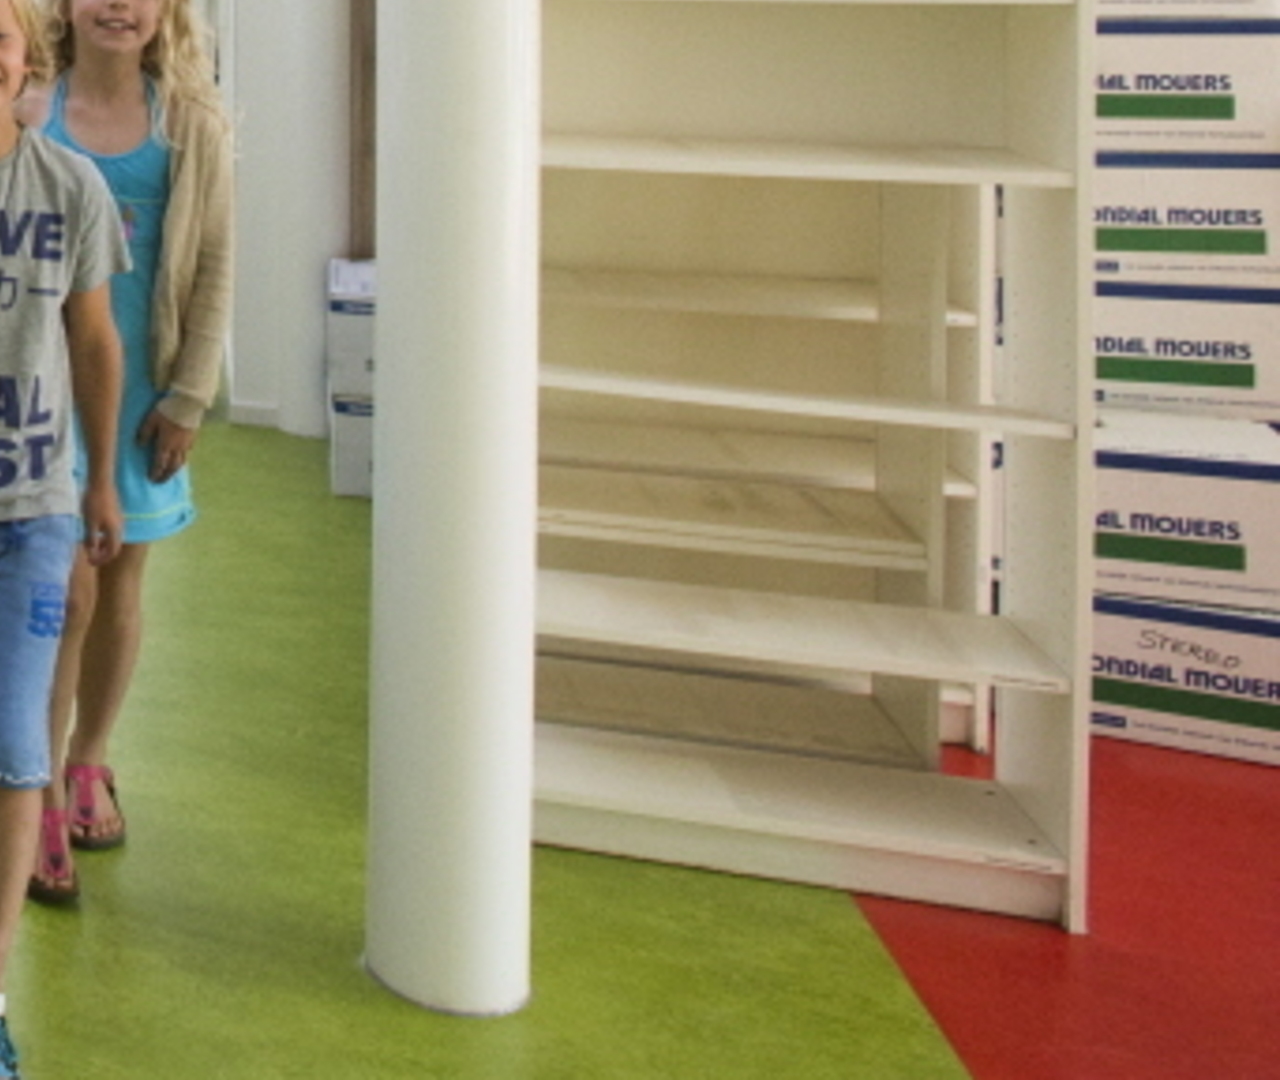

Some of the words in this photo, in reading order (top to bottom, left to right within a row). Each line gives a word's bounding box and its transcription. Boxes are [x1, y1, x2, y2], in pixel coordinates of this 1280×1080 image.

[1136, 74, 1232, 91] MOVERS
[1167, 207, 1263, 226] MOVERS
[1154, 338, 1252, 360] MOVERS
[1129, 512, 1242, 541] MOVERS
